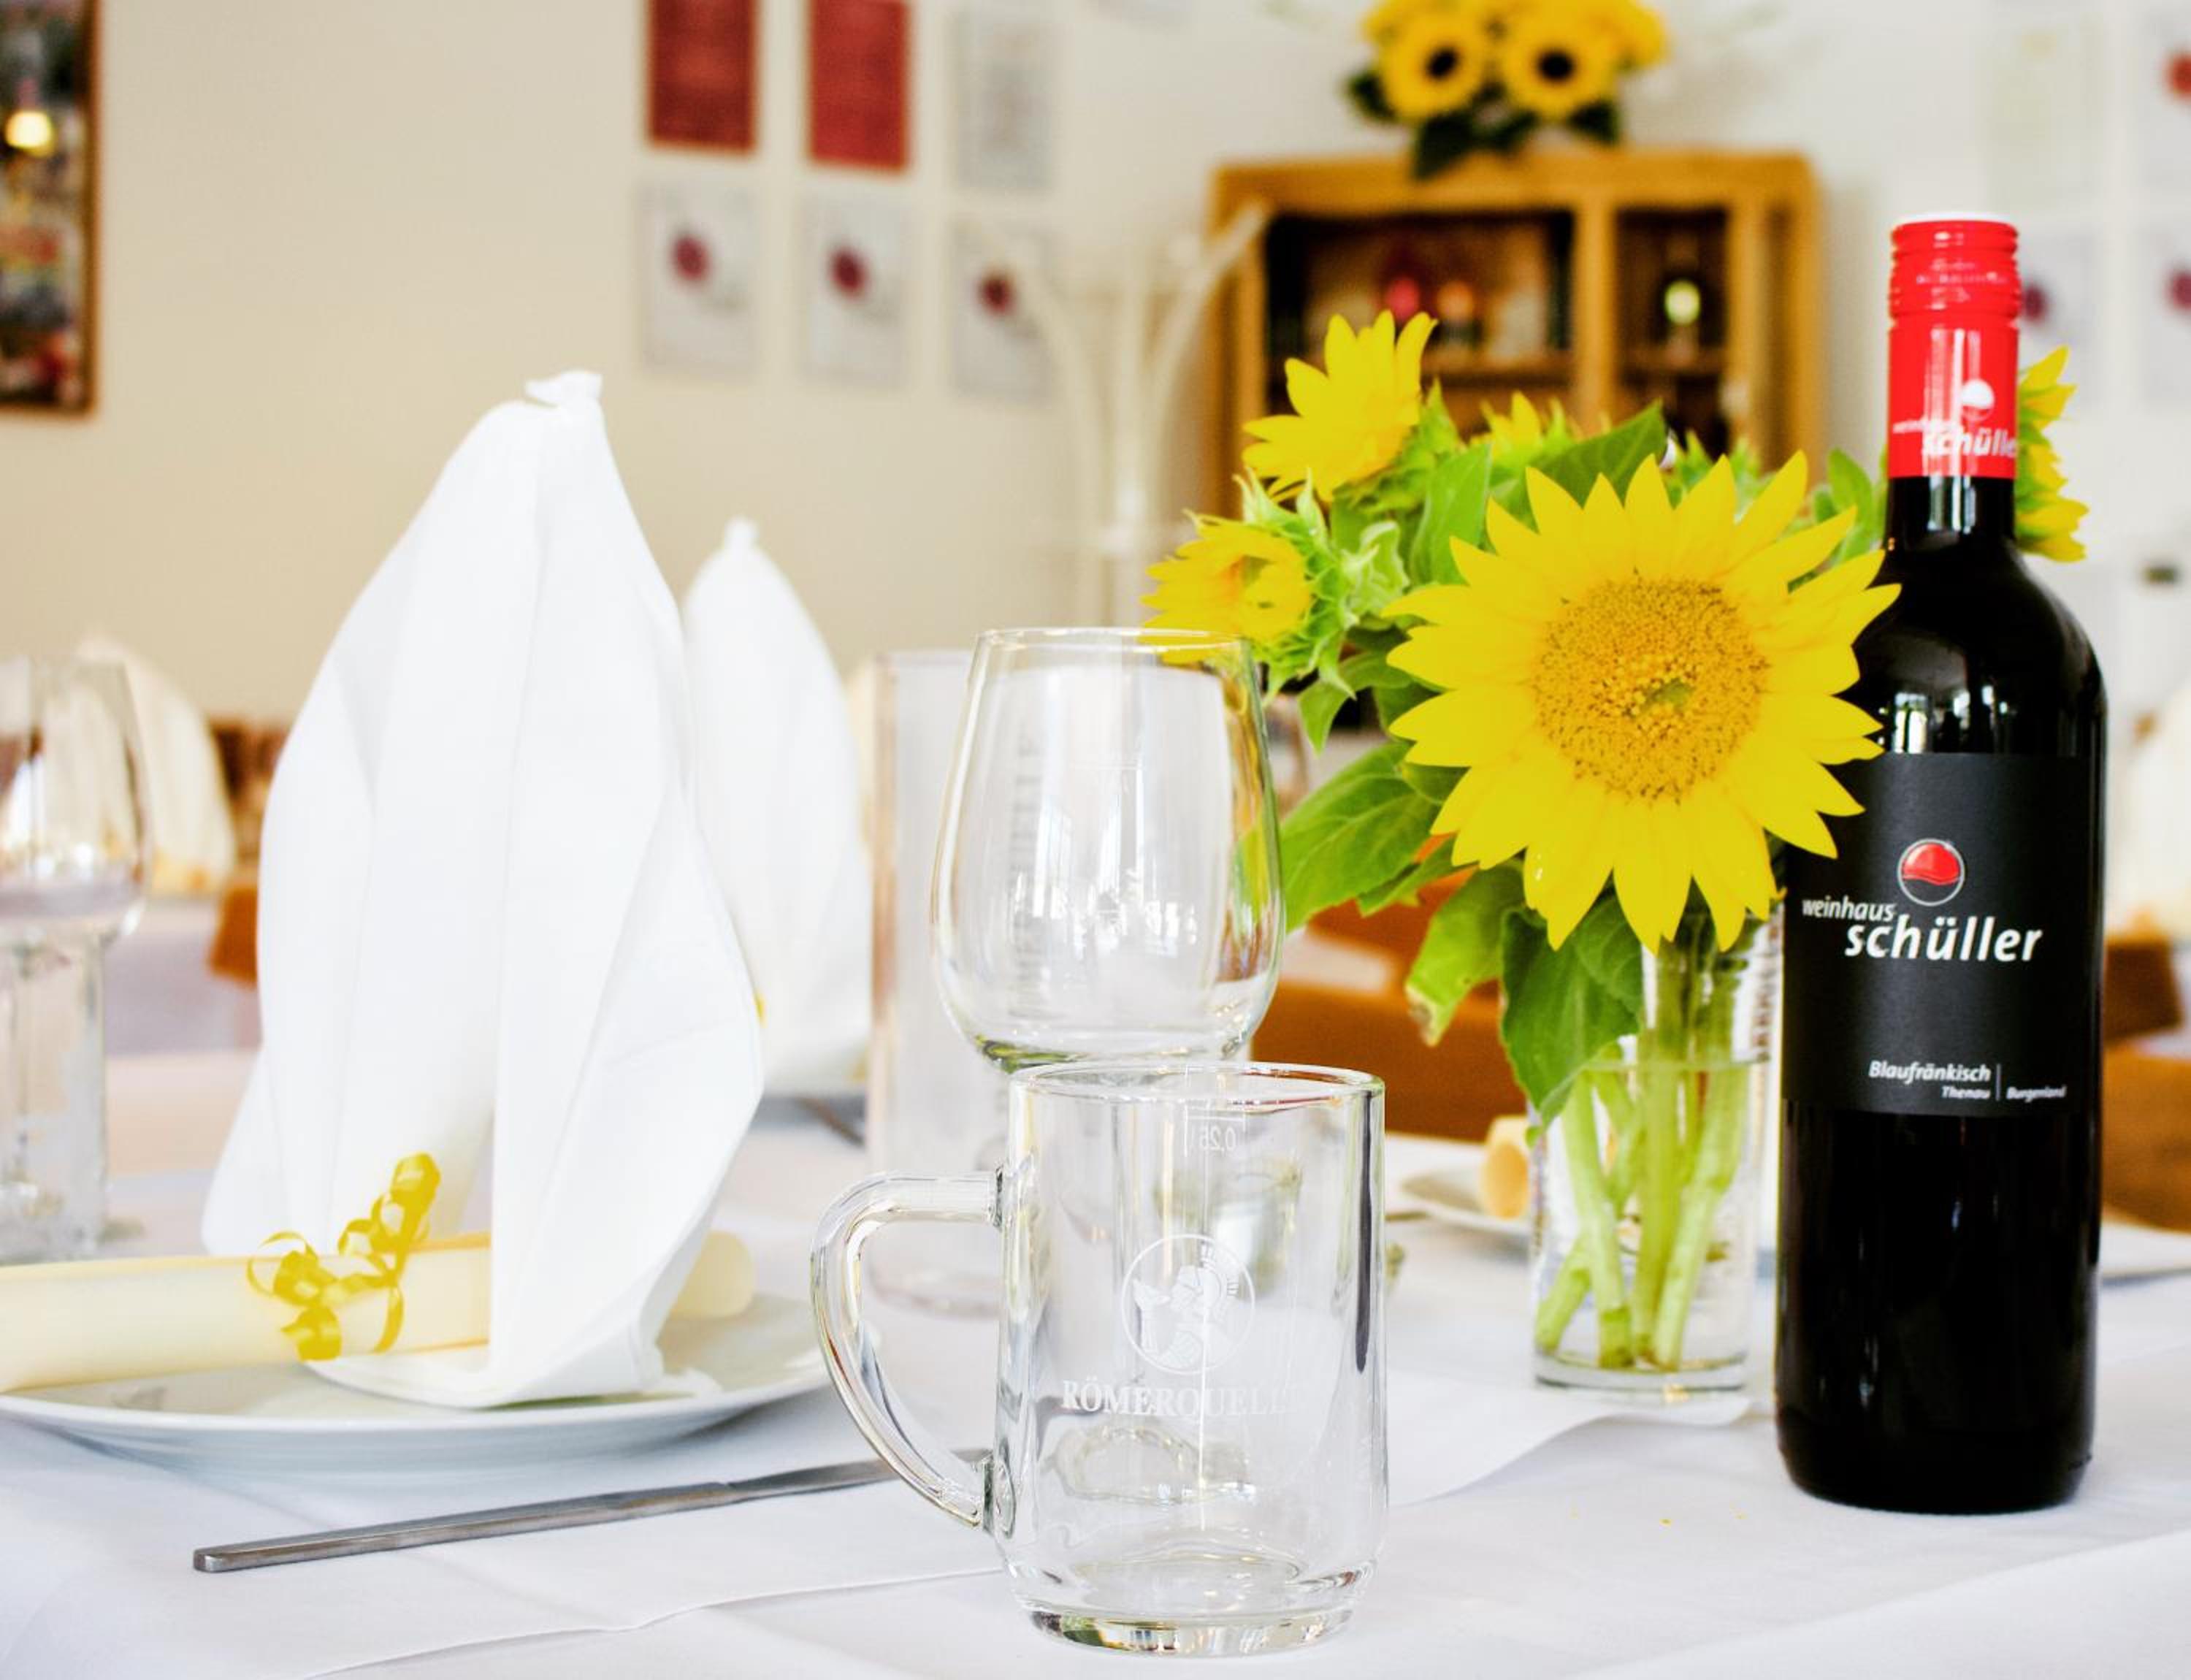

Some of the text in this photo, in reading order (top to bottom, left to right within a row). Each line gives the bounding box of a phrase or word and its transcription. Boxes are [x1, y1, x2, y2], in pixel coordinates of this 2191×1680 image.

[1802, 896, 1897, 923] weinhaus
[1845, 913, 2043, 961] schüller
[1869, 1061, 1991, 1085] Blaufränkisch
[1063, 1376, 1298, 1416] RÖMERQUELL
